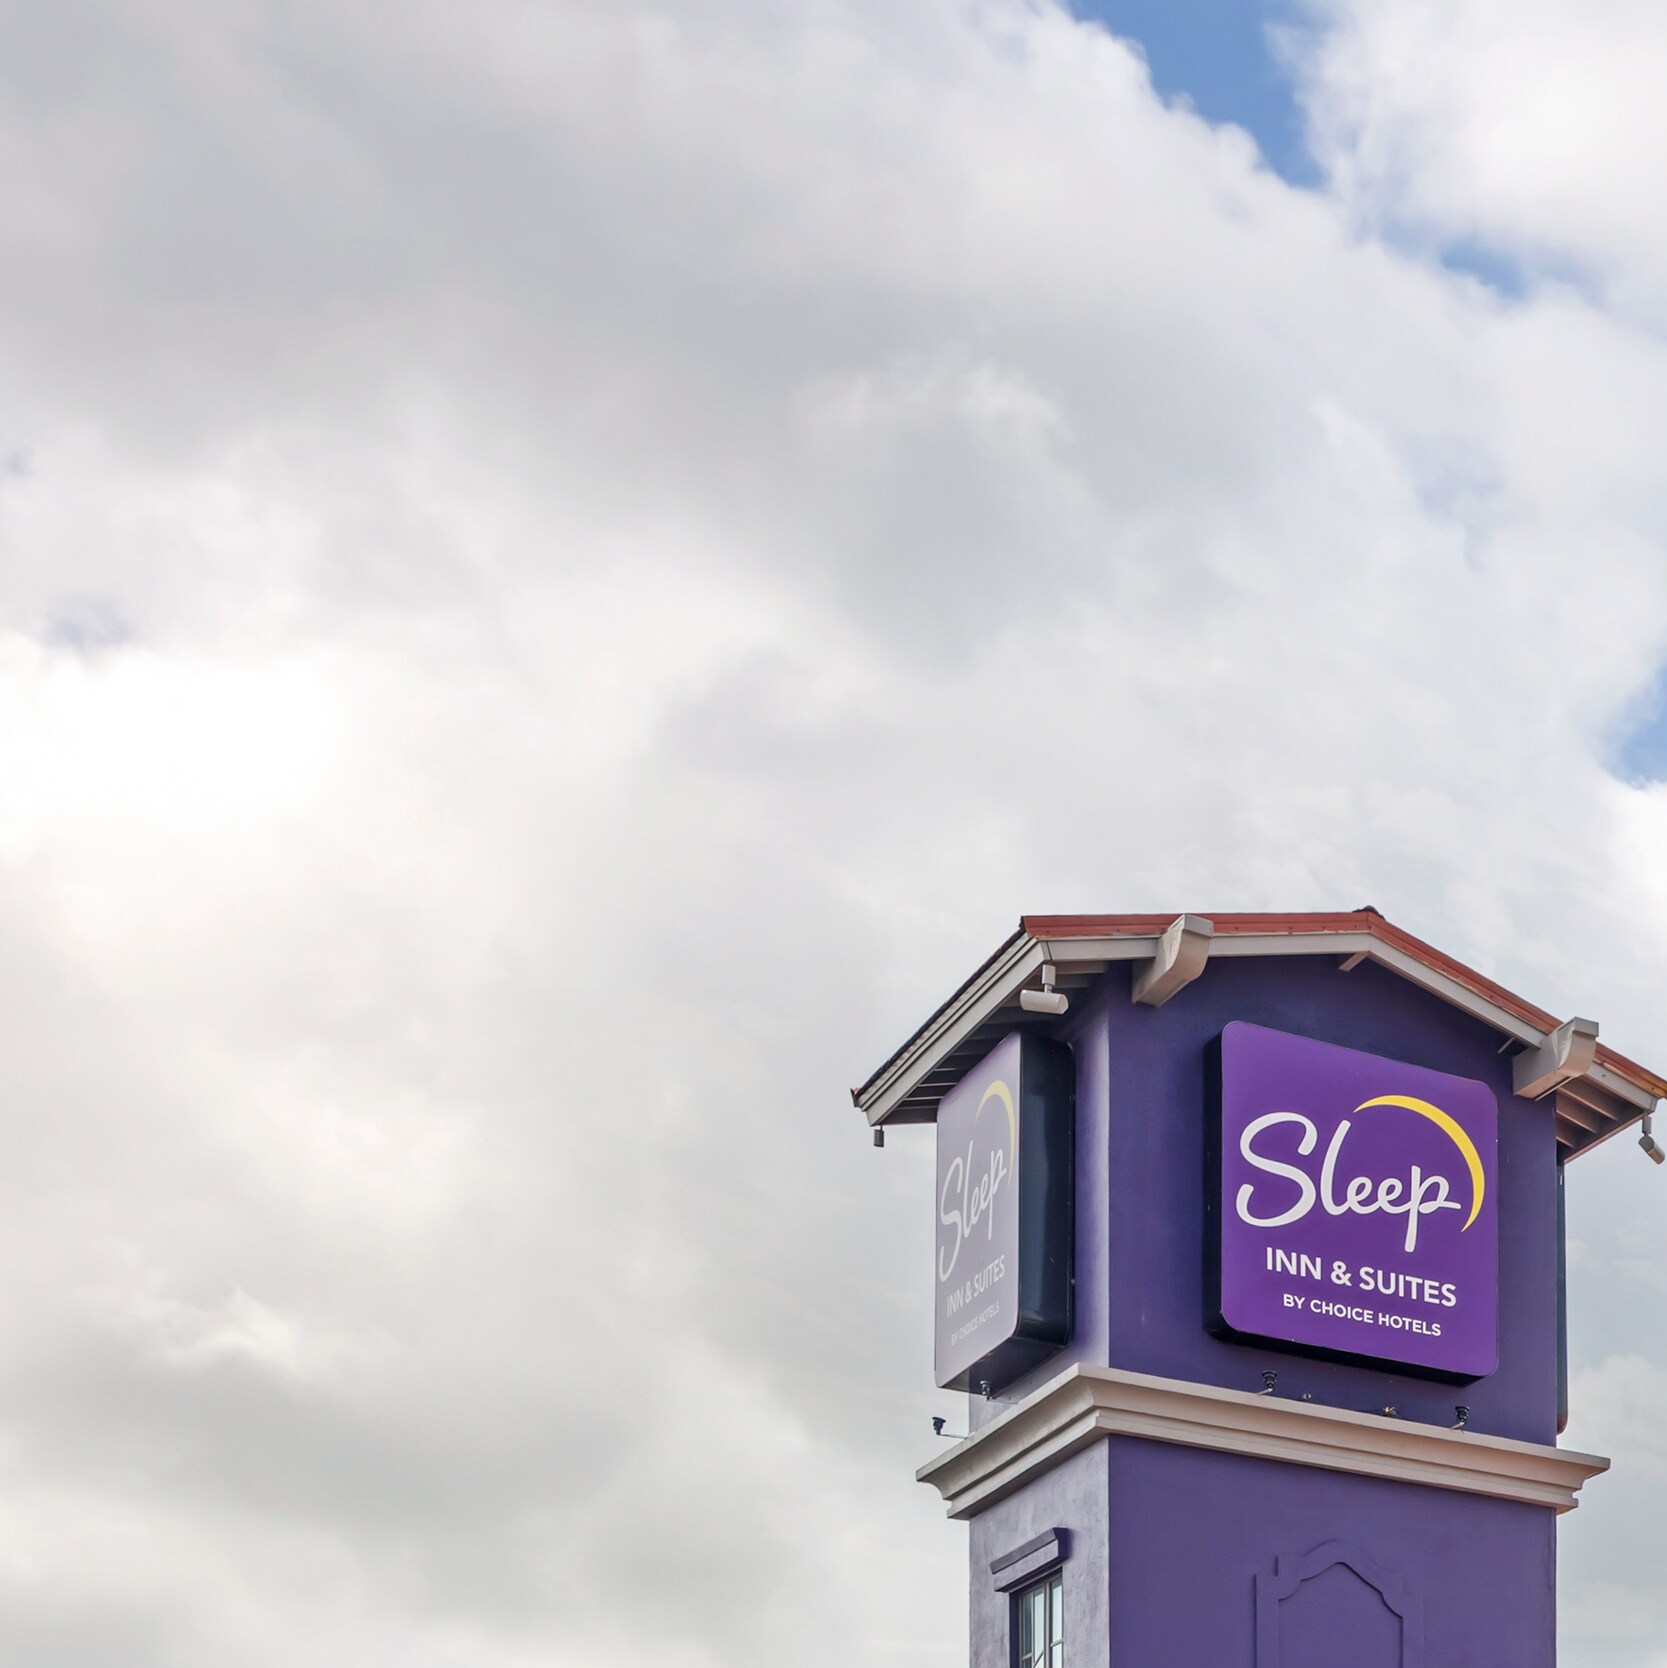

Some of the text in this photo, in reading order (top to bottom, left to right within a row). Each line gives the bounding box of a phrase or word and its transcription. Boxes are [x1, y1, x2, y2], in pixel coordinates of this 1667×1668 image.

[939, 1140, 1007, 1282] Sleep
[1236, 1112, 1461, 1252] Sleep
[946, 1254, 1005, 1318] INN & SUITES
[1266, 1247, 1457, 1308] INN & SUITES
[1283, 1293, 1441, 1337] BY CHOICE HOTELS
